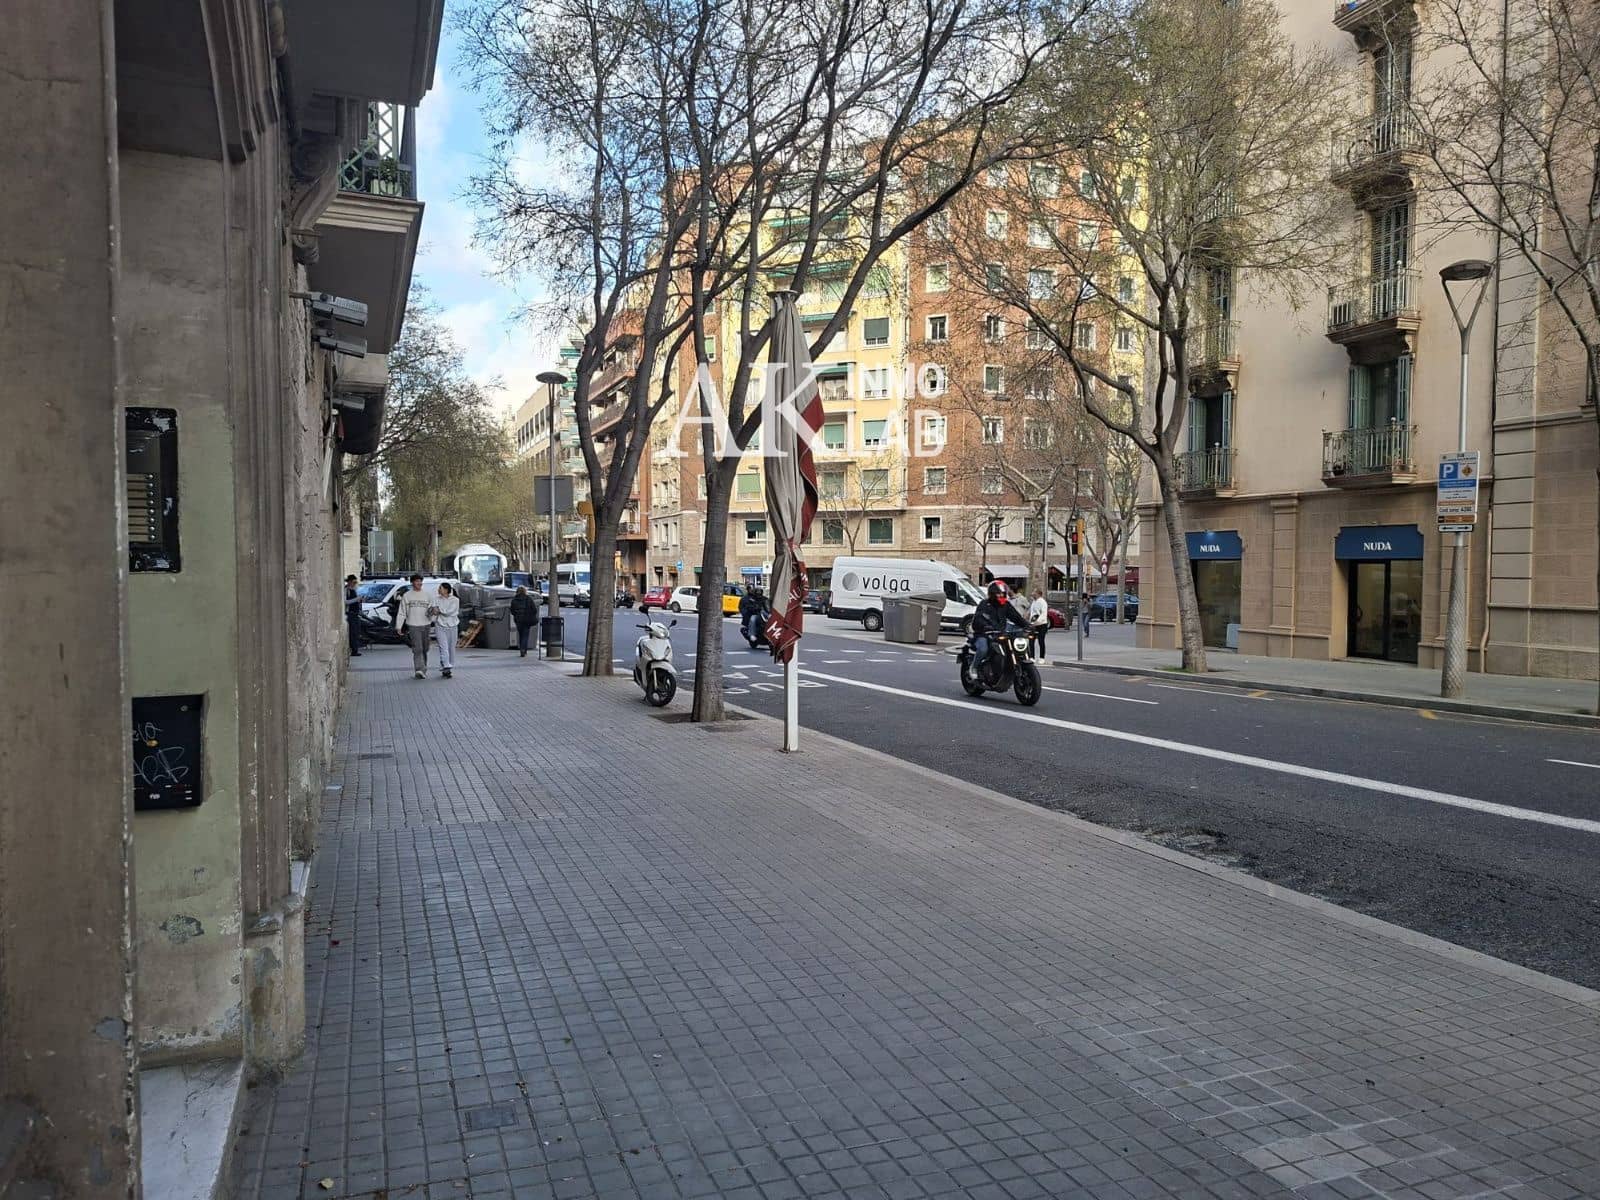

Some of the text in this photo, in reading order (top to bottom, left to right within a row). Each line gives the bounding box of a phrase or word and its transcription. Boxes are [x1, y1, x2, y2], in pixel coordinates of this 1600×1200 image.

[1442, 464, 1454, 479] P
[1199, 544, 1220, 553] NUDA
[1362, 541, 1392, 551] NUDA
[862, 574, 911, 593] volga
